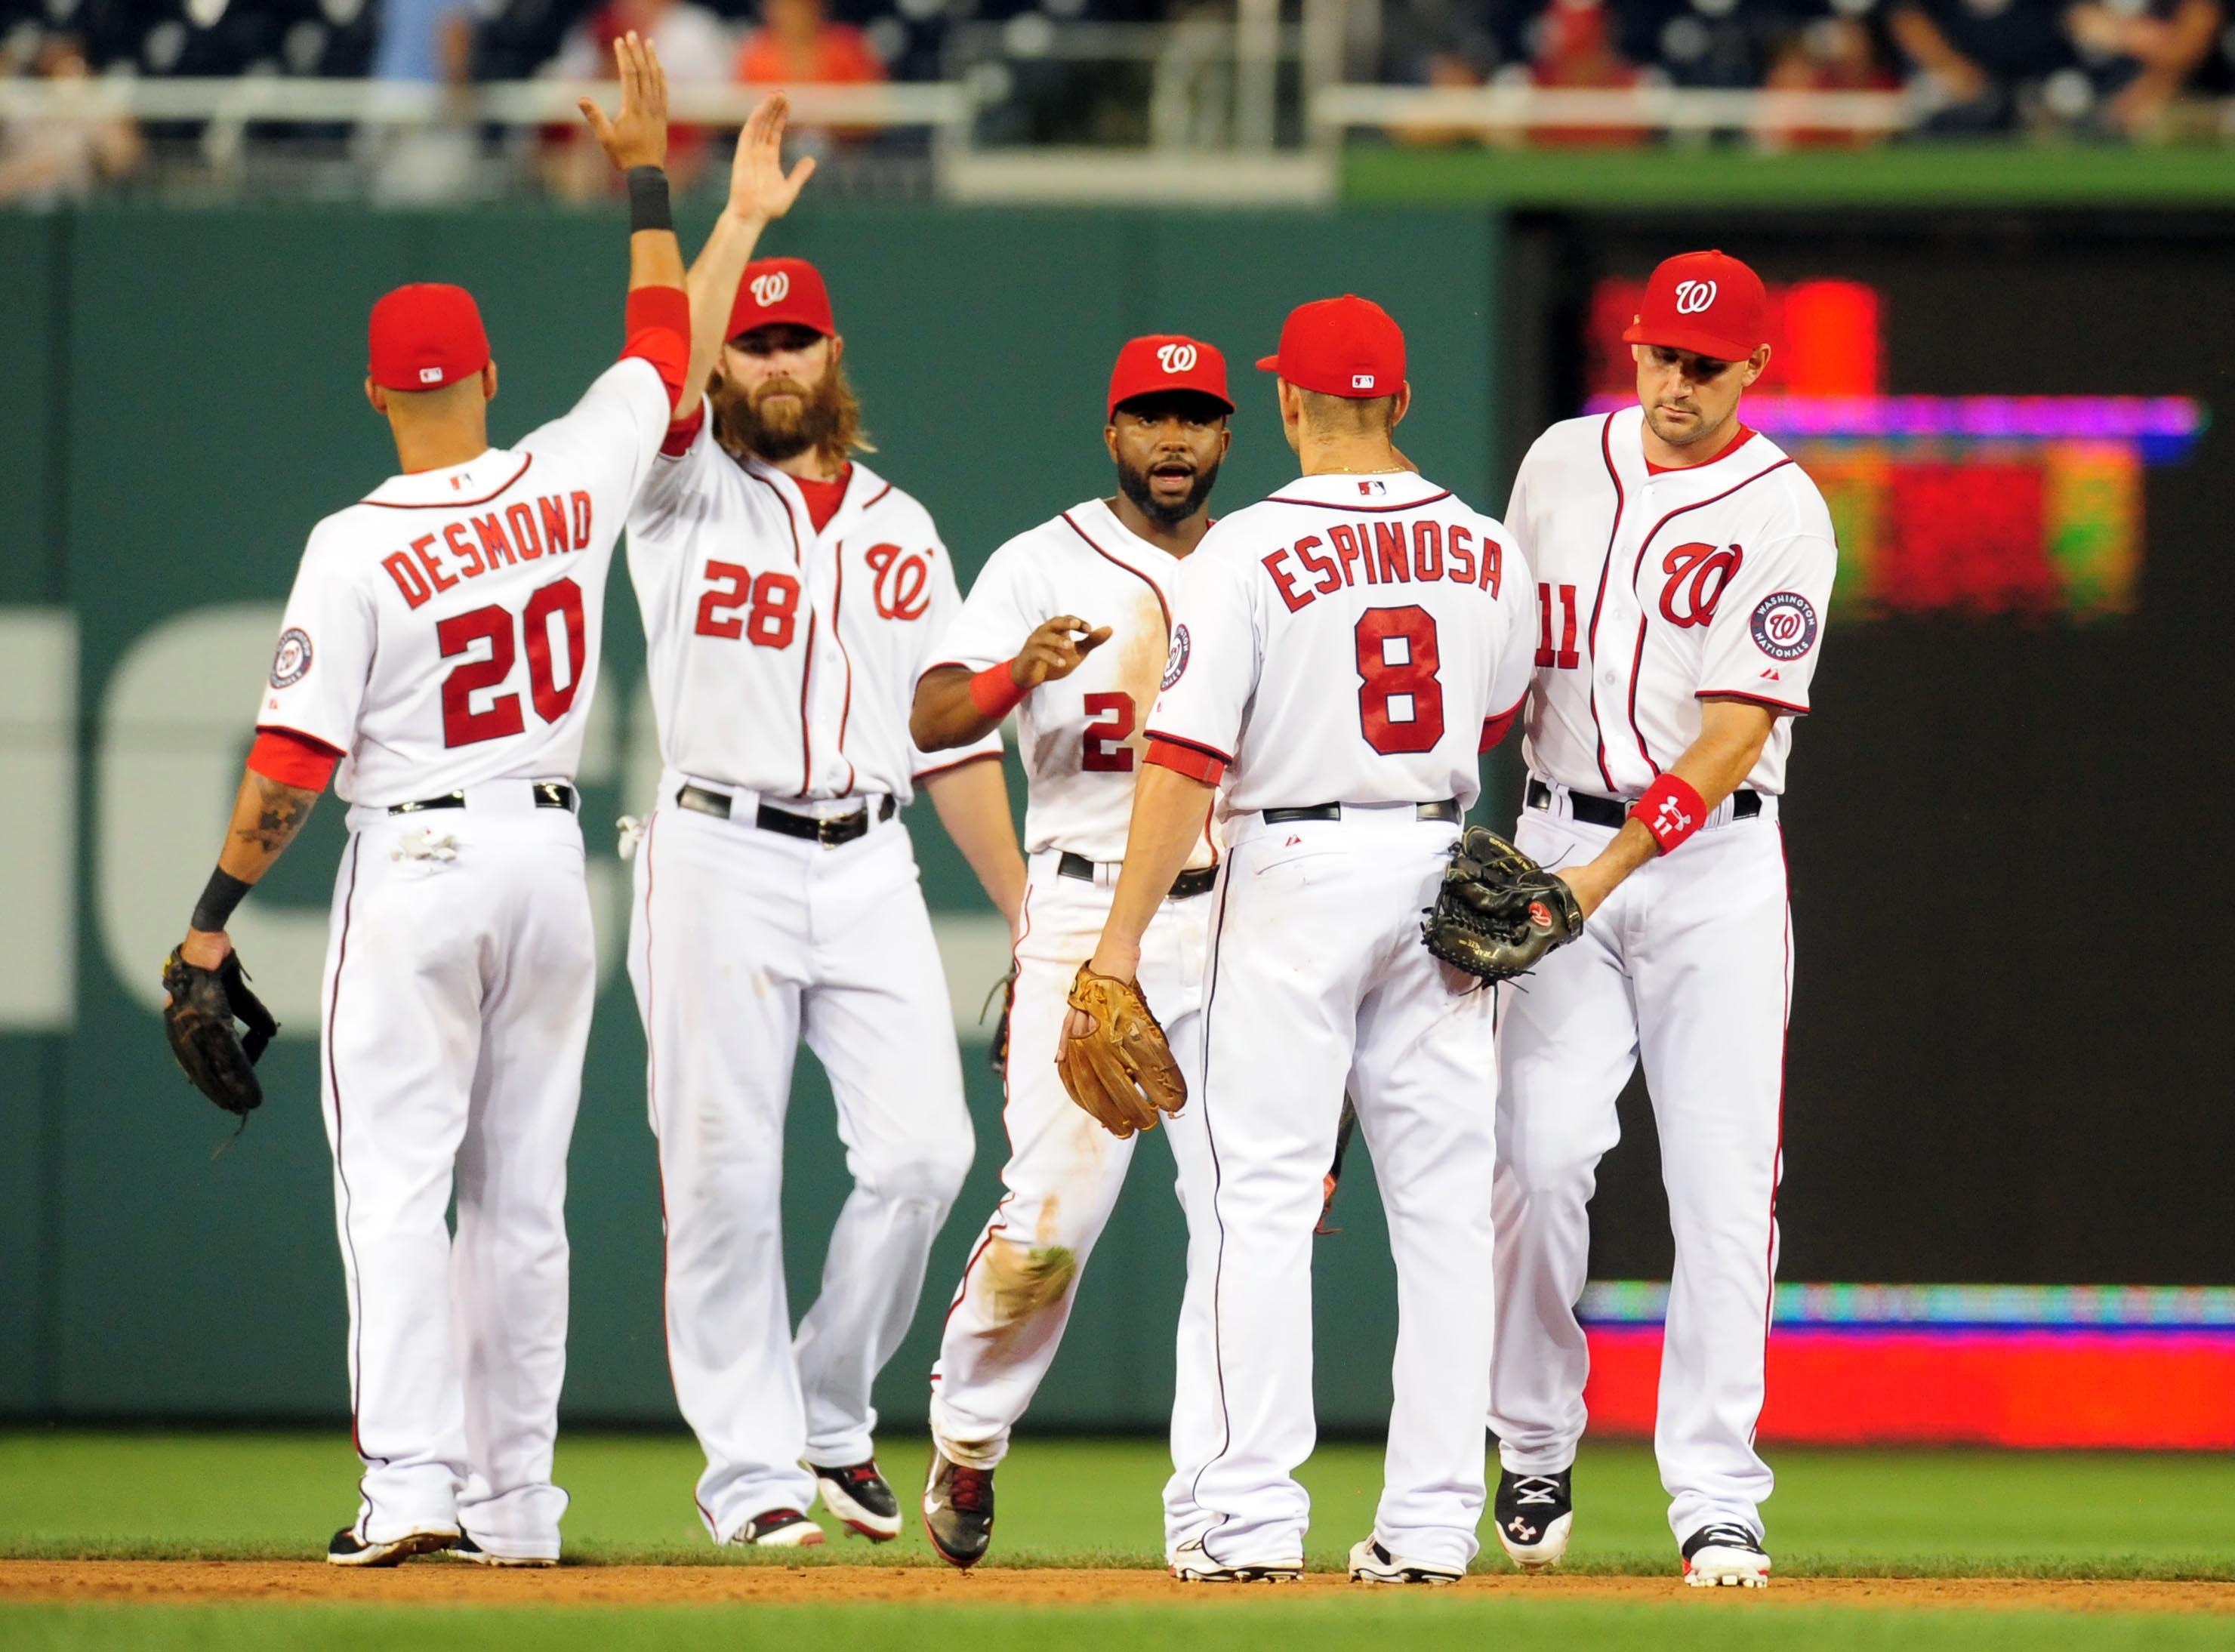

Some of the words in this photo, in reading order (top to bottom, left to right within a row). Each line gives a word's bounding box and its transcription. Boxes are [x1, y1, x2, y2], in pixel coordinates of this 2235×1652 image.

[751, 270, 789, 307] W
[1675, 279, 1716, 313] W
[1156, 343, 1198, 374] W
[381, 490, 592, 609] DESMOND
[865, 541, 935, 621] W
[1260, 520, 1503, 614] ESPINOSA
[1659, 541, 1743, 628] W
[695, 559, 801, 650] 28
[1534, 581, 1580, 670] 11
[1755, 632, 1809, 658] NATIONALS
[1757, 594, 1816, 627] WASHINGTON
[436, 576, 587, 749] 20
[1354, 604, 1445, 757] 8
[1082, 691, 1136, 772] 2
[1652, 814, 1674, 838] 11
